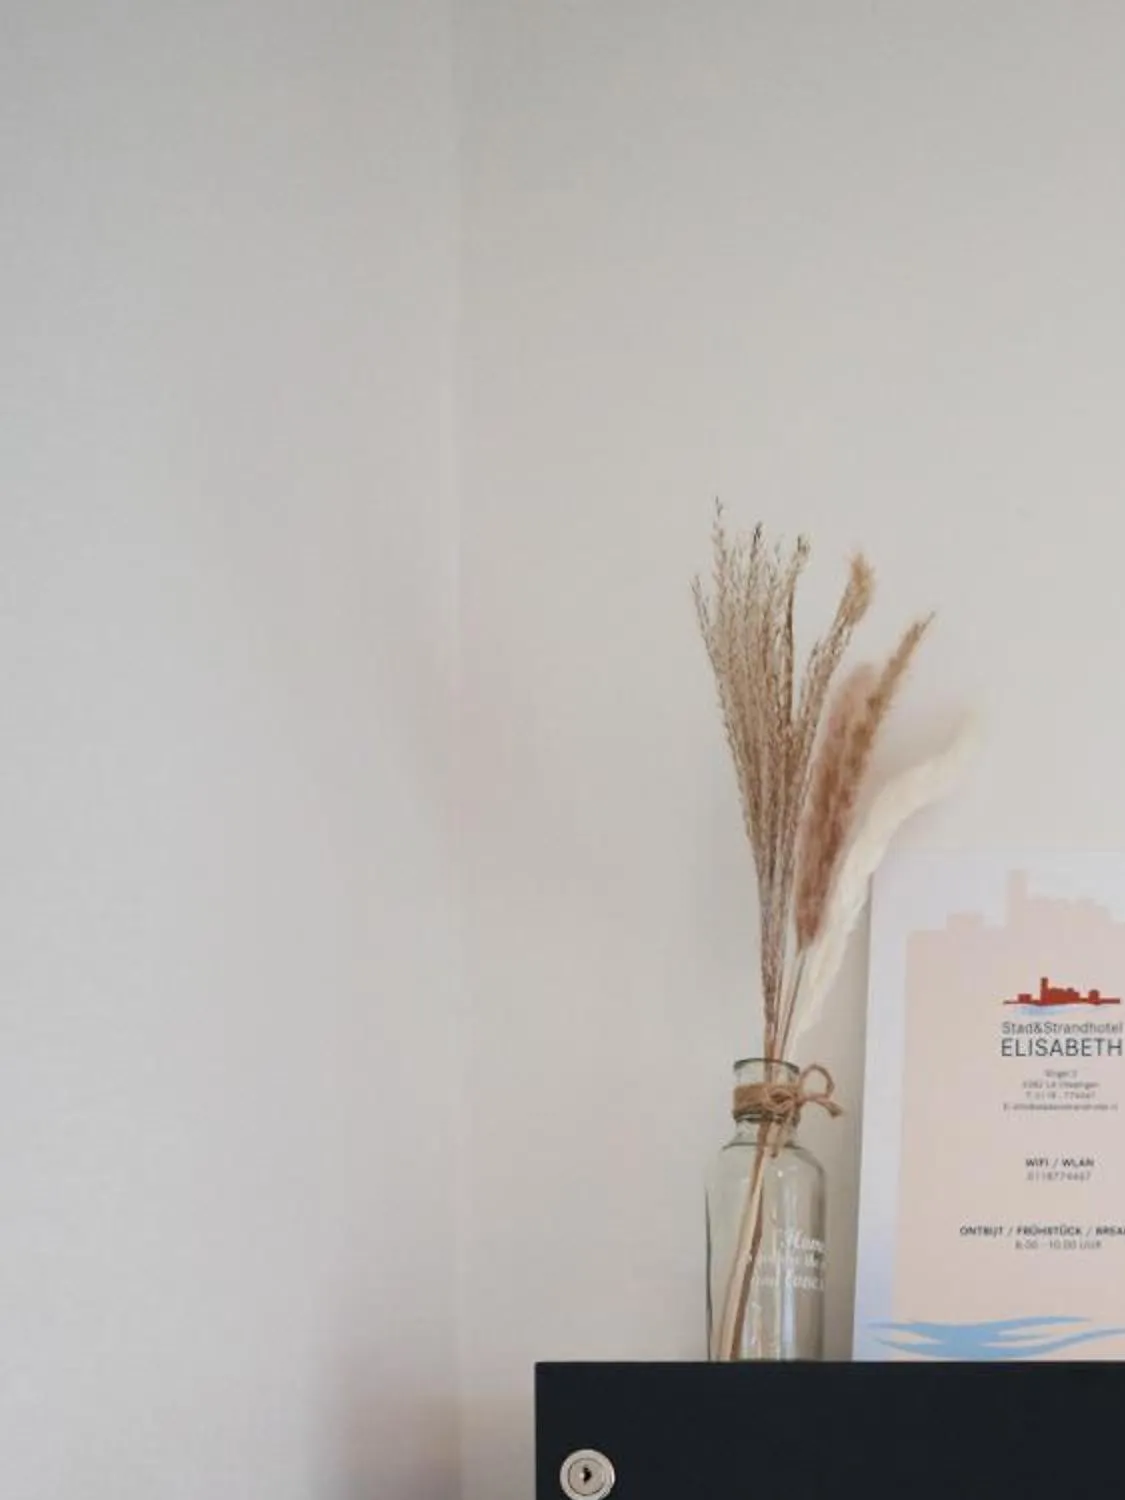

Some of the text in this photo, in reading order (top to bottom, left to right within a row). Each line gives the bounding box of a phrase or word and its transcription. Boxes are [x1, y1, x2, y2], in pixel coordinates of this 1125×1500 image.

[1001, 1038, 1122, 1057] ELISABETH
[1026, 1158, 1049, 1167] WIFI
[1062, 1158, 1094, 1167] WLAN
